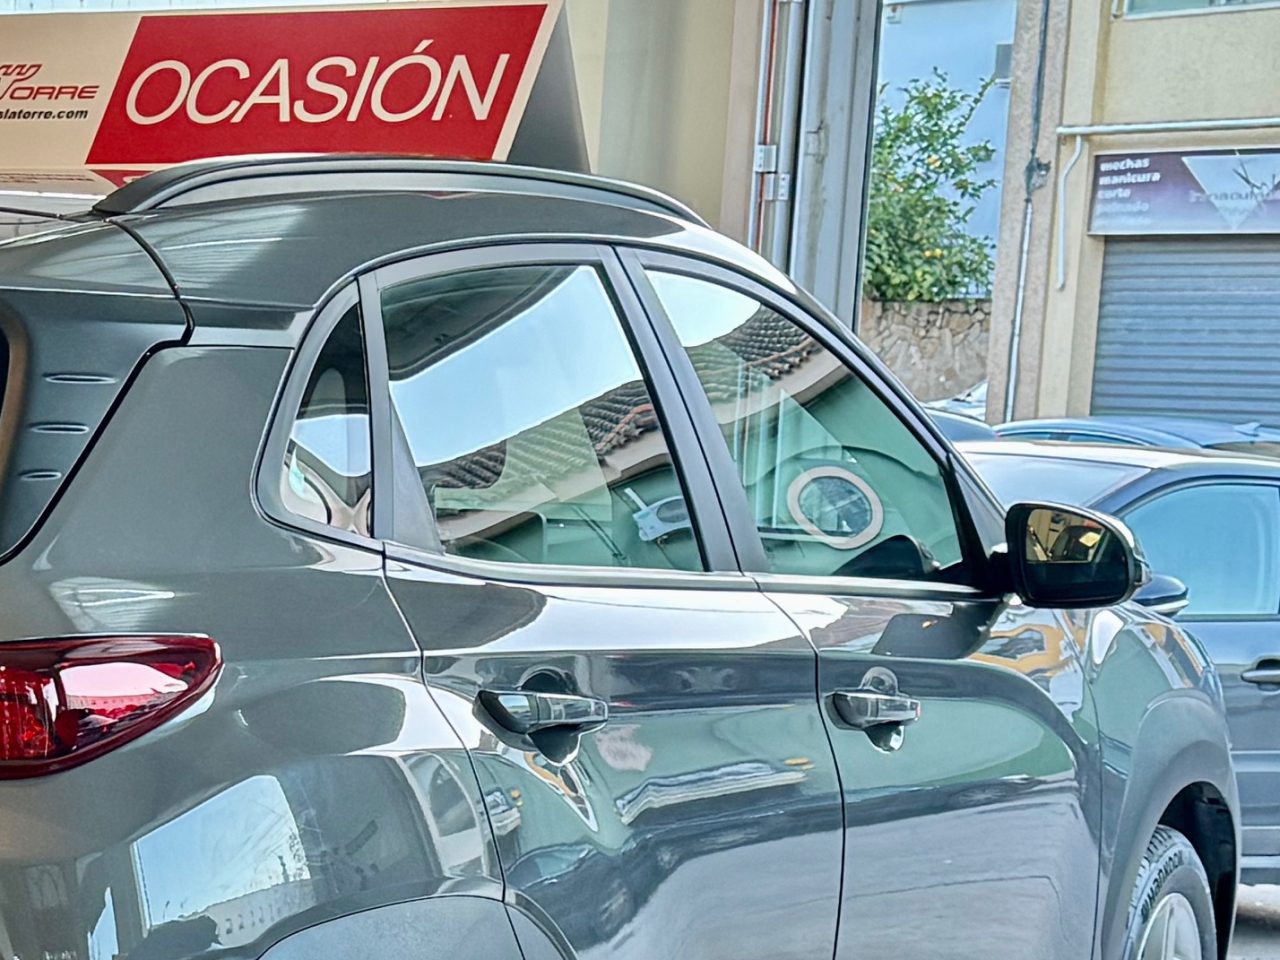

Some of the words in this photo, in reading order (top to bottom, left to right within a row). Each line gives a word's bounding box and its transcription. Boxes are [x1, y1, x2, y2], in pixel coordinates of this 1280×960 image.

[125, 39, 511, 125] OCASIÓN
[1100, 157, 1151, 172] mechas
[1098, 172, 1162, 186] manicura
[1097, 187, 1132, 200] corte
